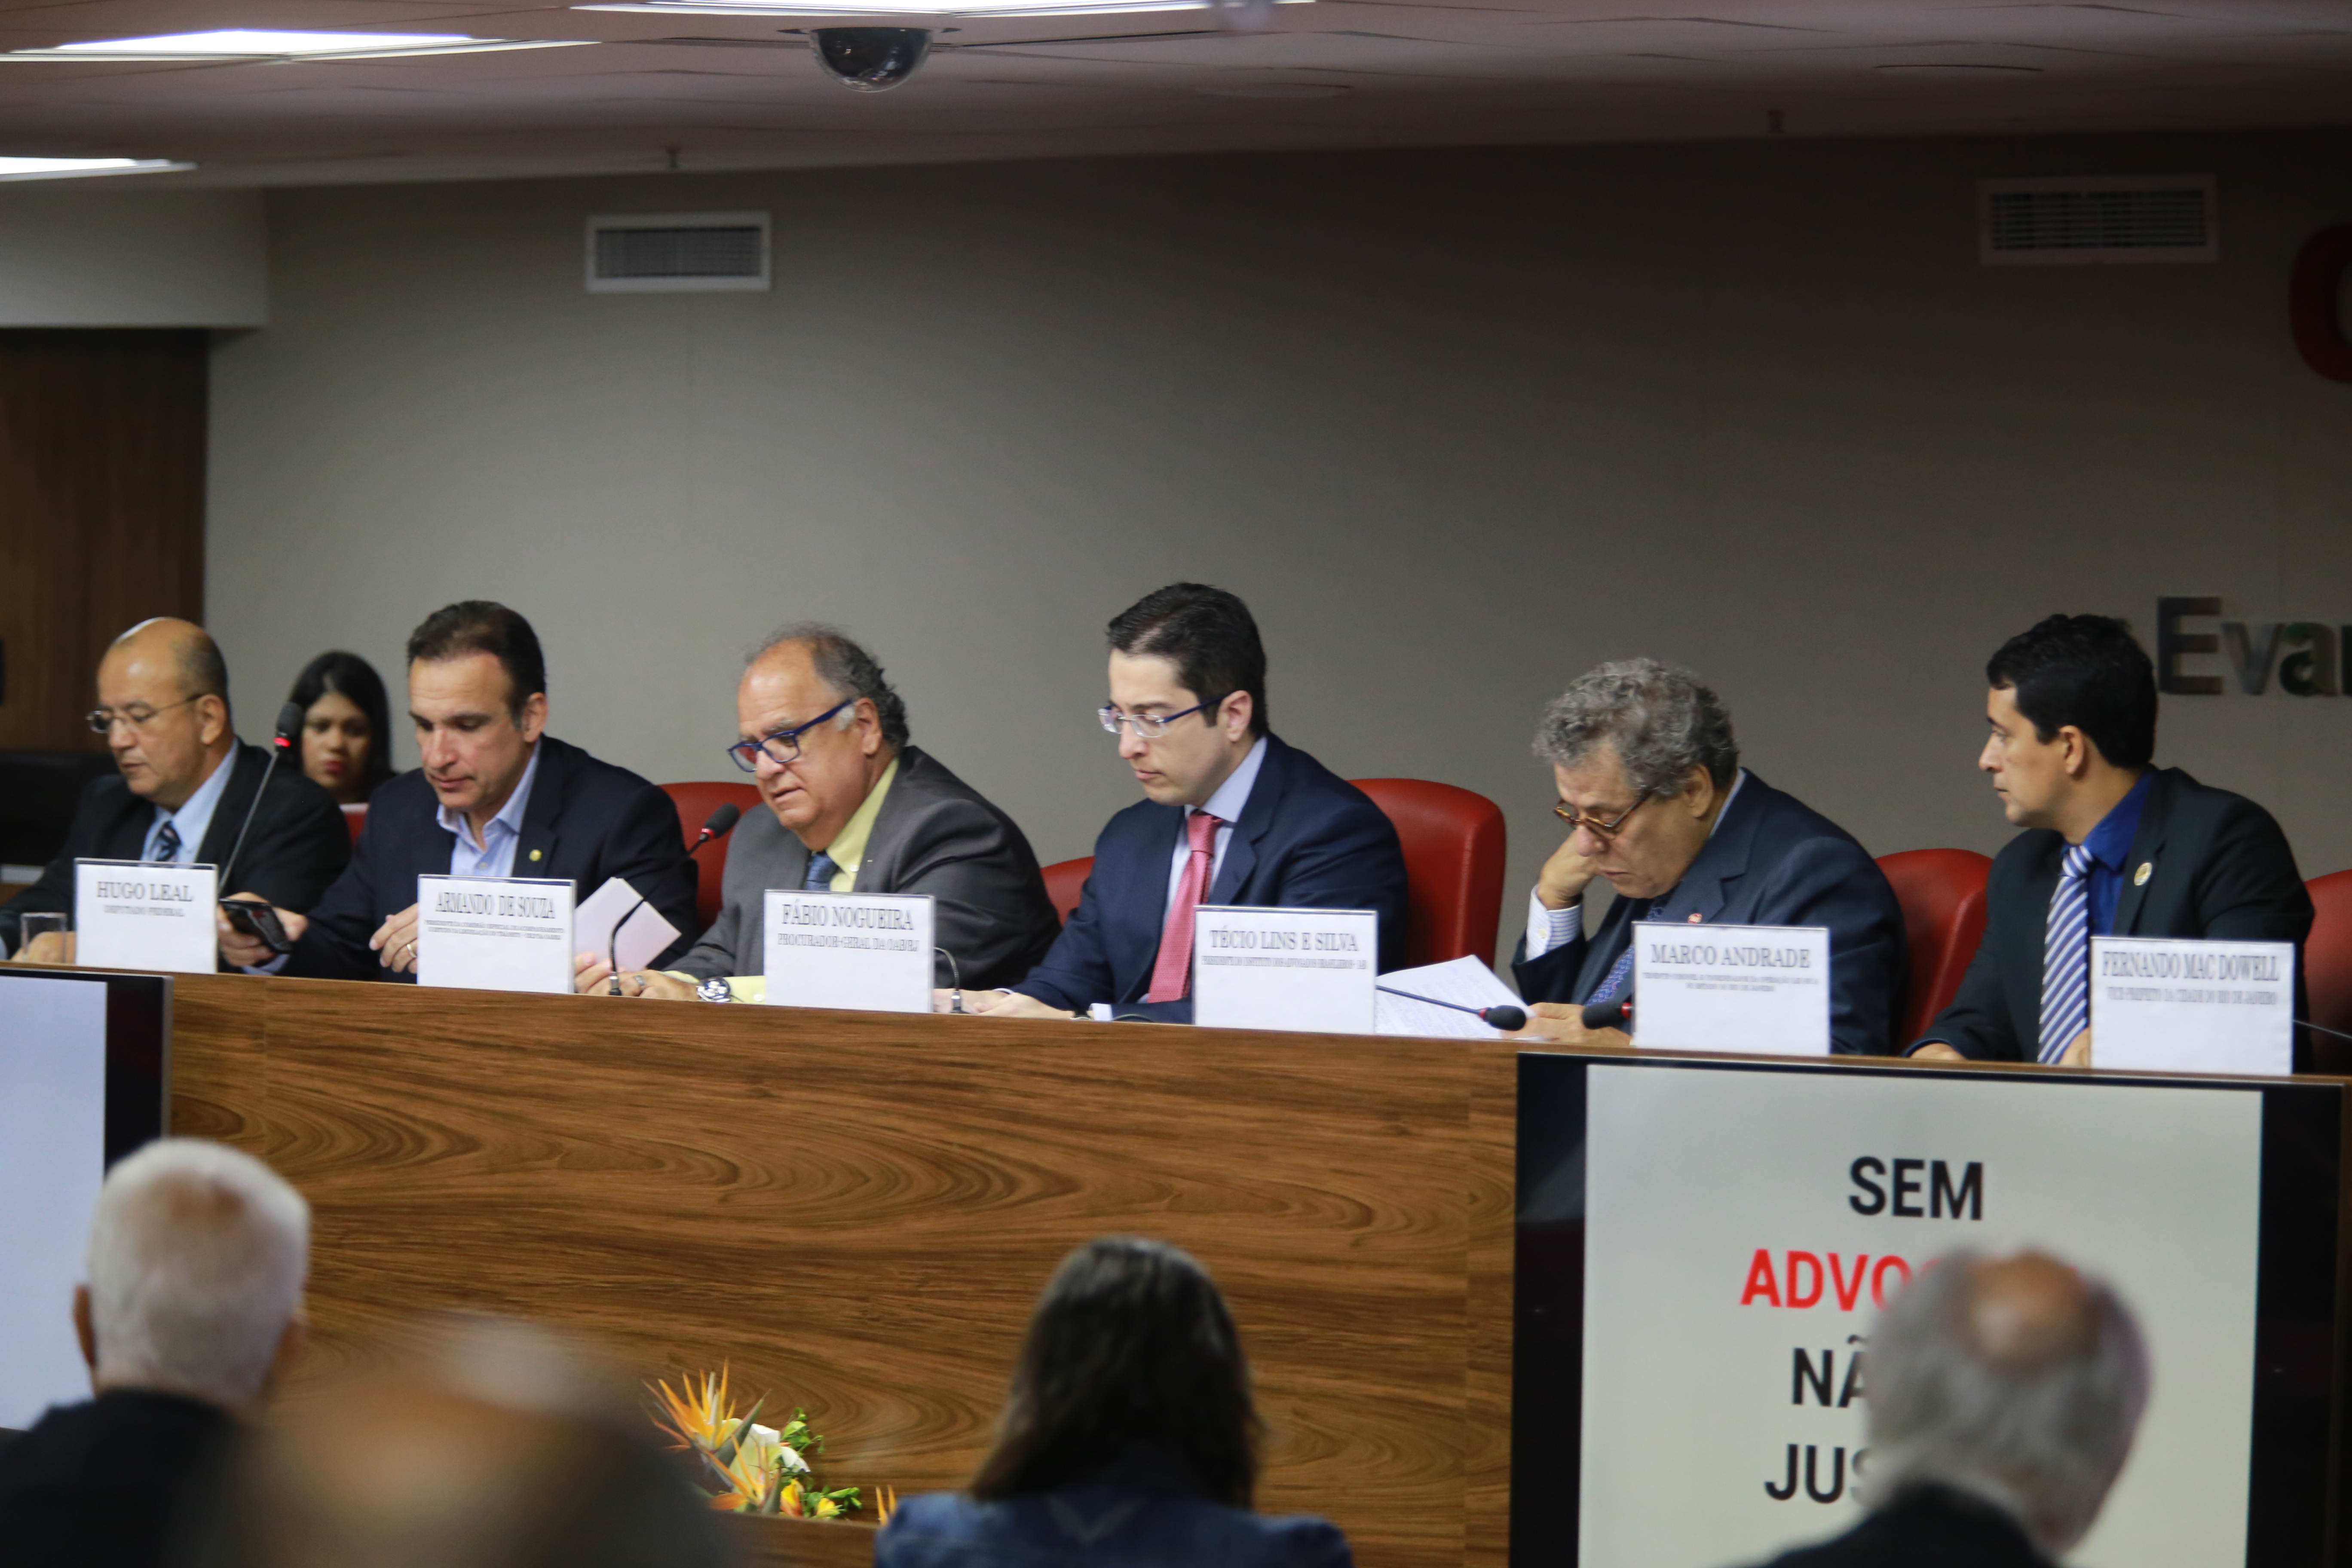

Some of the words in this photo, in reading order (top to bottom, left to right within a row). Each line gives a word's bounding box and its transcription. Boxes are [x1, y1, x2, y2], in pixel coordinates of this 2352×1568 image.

[2157, 597, 2352, 696] Eva
[97, 881, 145, 899] HUGO
[150, 884, 192, 902] LEAL
[435, 892, 494, 915] ARMANDO
[499, 895, 515, 916] DE
[517, 897, 556, 919] SOUZA
[781, 898, 827, 926] FÁBIO
[832, 906, 914, 931] NOGUEIRA
[873, 938, 886, 950] DA
[1210, 925, 1256, 949] TÉCIO
[1261, 931, 1296, 950] LINS
[1302, 932, 1310, 951] E
[1315, 933, 1359, 952] SILVA
[1651, 944, 1717, 965] MARCO
[1721, 947, 1810, 968] ANDRADE
[2102, 951, 2180, 978] FERNANDO
[2184, 953, 2216, 980] MAC
[2219, 955, 2279, 981] DOWELL
[1848, 1156, 1983, 1221] SEM
[1740, 1249, 1939, 1311] ADVO
[1792, 1334, 1868, 1408] NÃ
